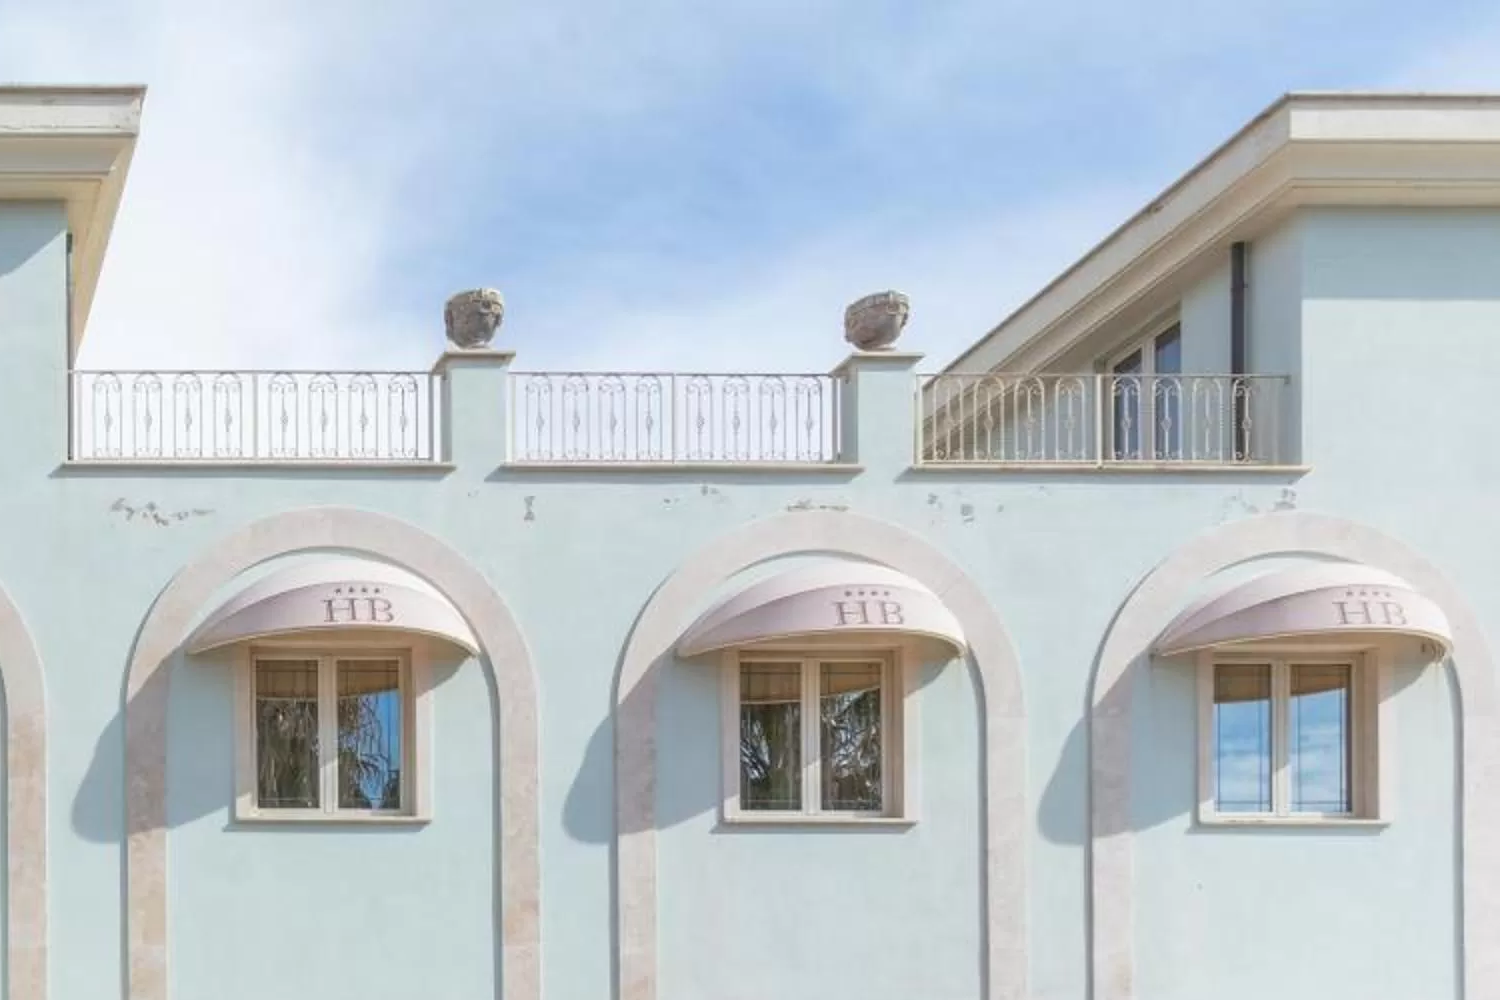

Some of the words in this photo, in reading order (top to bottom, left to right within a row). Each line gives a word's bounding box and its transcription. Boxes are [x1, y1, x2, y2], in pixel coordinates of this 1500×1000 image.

[322, 598, 395, 622] HB
[833, 601, 904, 625] HB
[1331, 601, 1407, 625] HB
